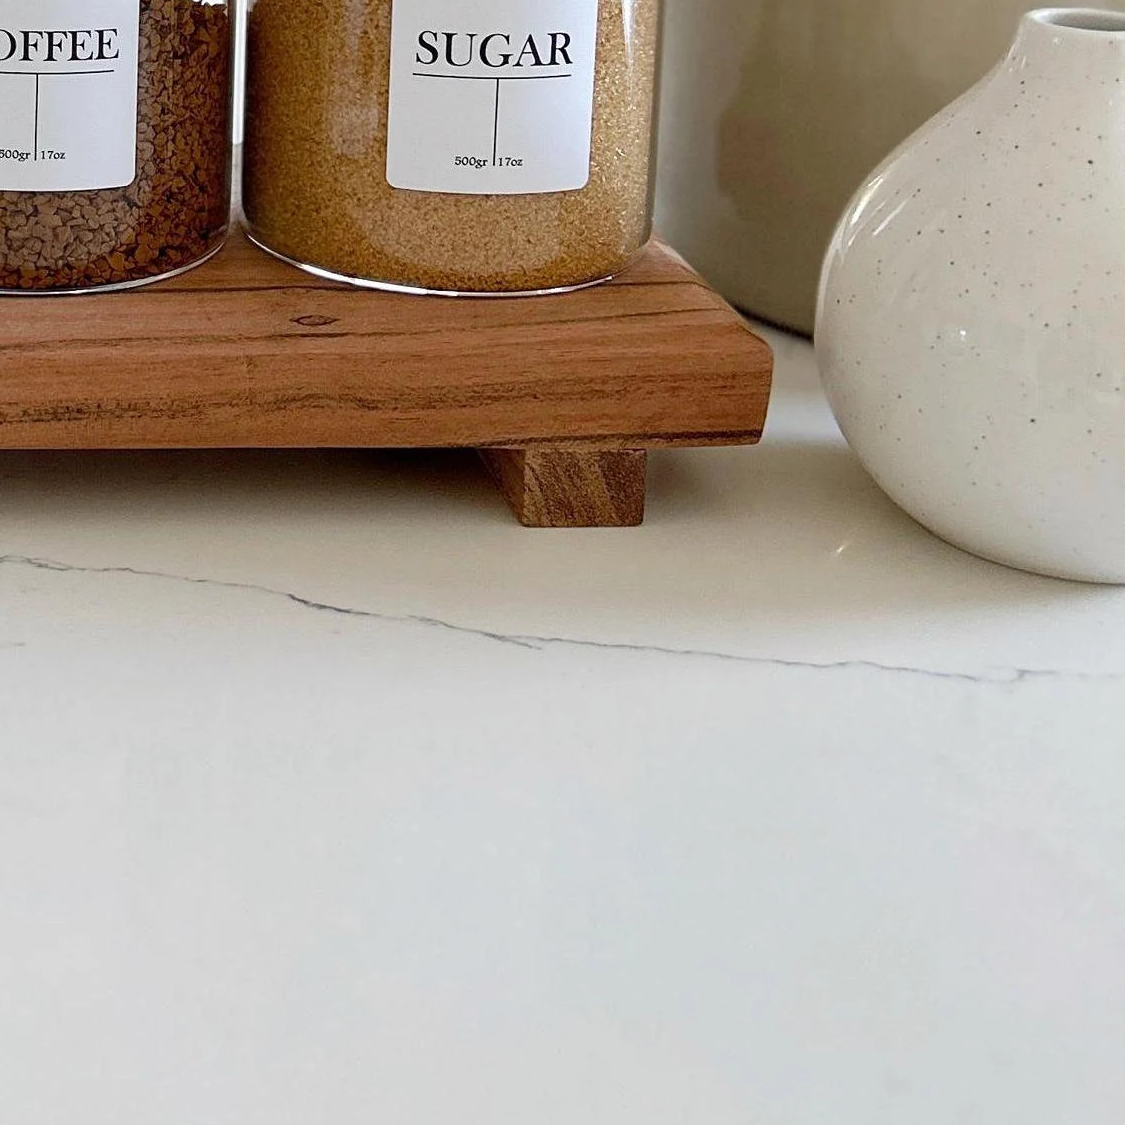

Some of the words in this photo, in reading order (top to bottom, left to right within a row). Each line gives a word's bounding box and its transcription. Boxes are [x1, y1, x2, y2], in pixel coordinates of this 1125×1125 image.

[415, 30, 574, 68] SUGAR
[40, 150, 66, 160] 17oz
[454, 155, 489, 169] 500gr
[498, 156, 523, 167] 17oz
